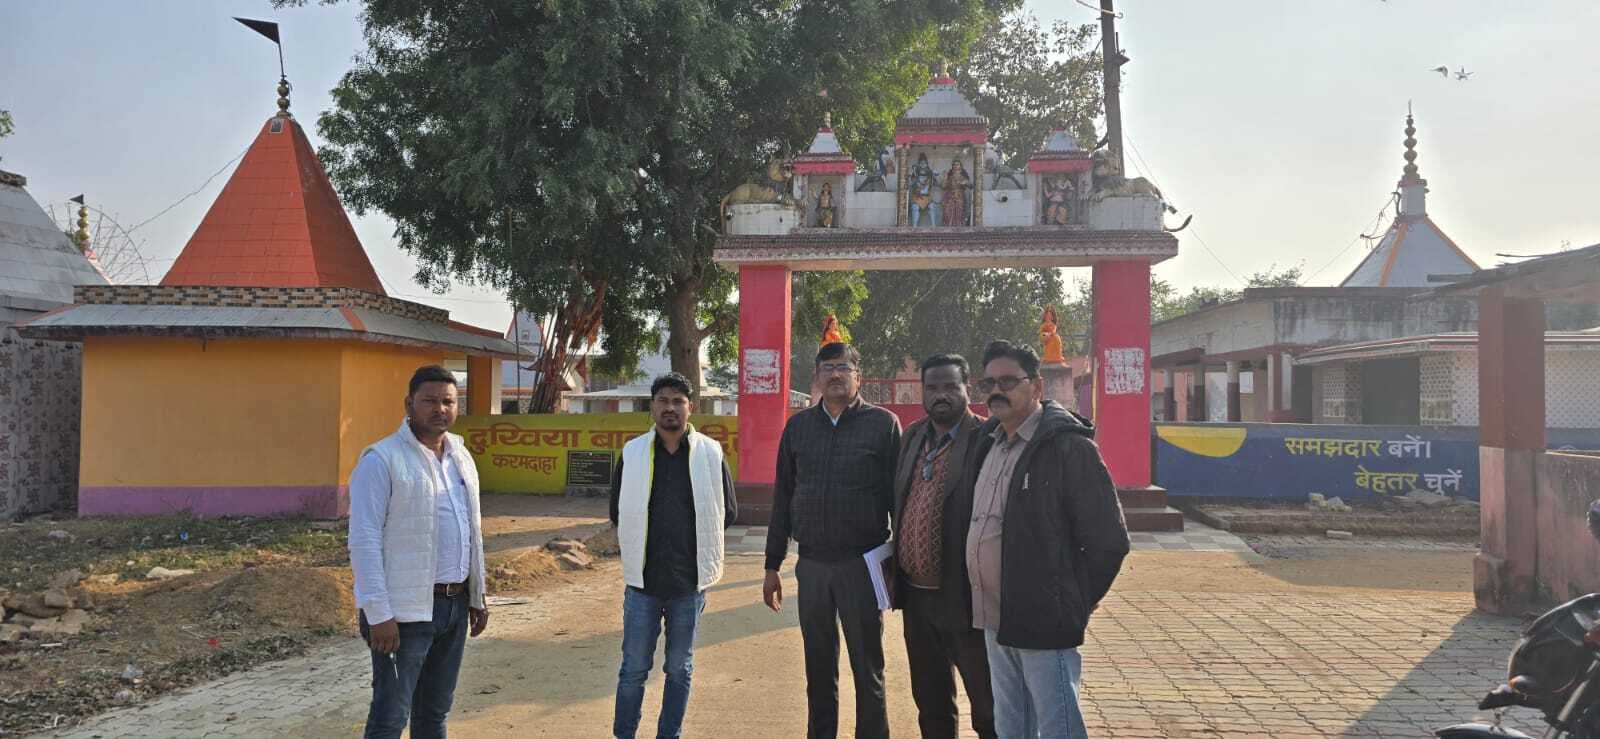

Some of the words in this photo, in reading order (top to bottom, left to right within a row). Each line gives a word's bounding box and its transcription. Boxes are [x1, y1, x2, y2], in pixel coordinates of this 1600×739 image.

[468, 423, 581, 455] दुखिया
[1285, 438, 1382, 458] समझदार
[492, 454, 559, 475] करमदाहा
[1354, 465, 1419, 493] बेहतर
[1424, 468, 1463, 496] चुनें
